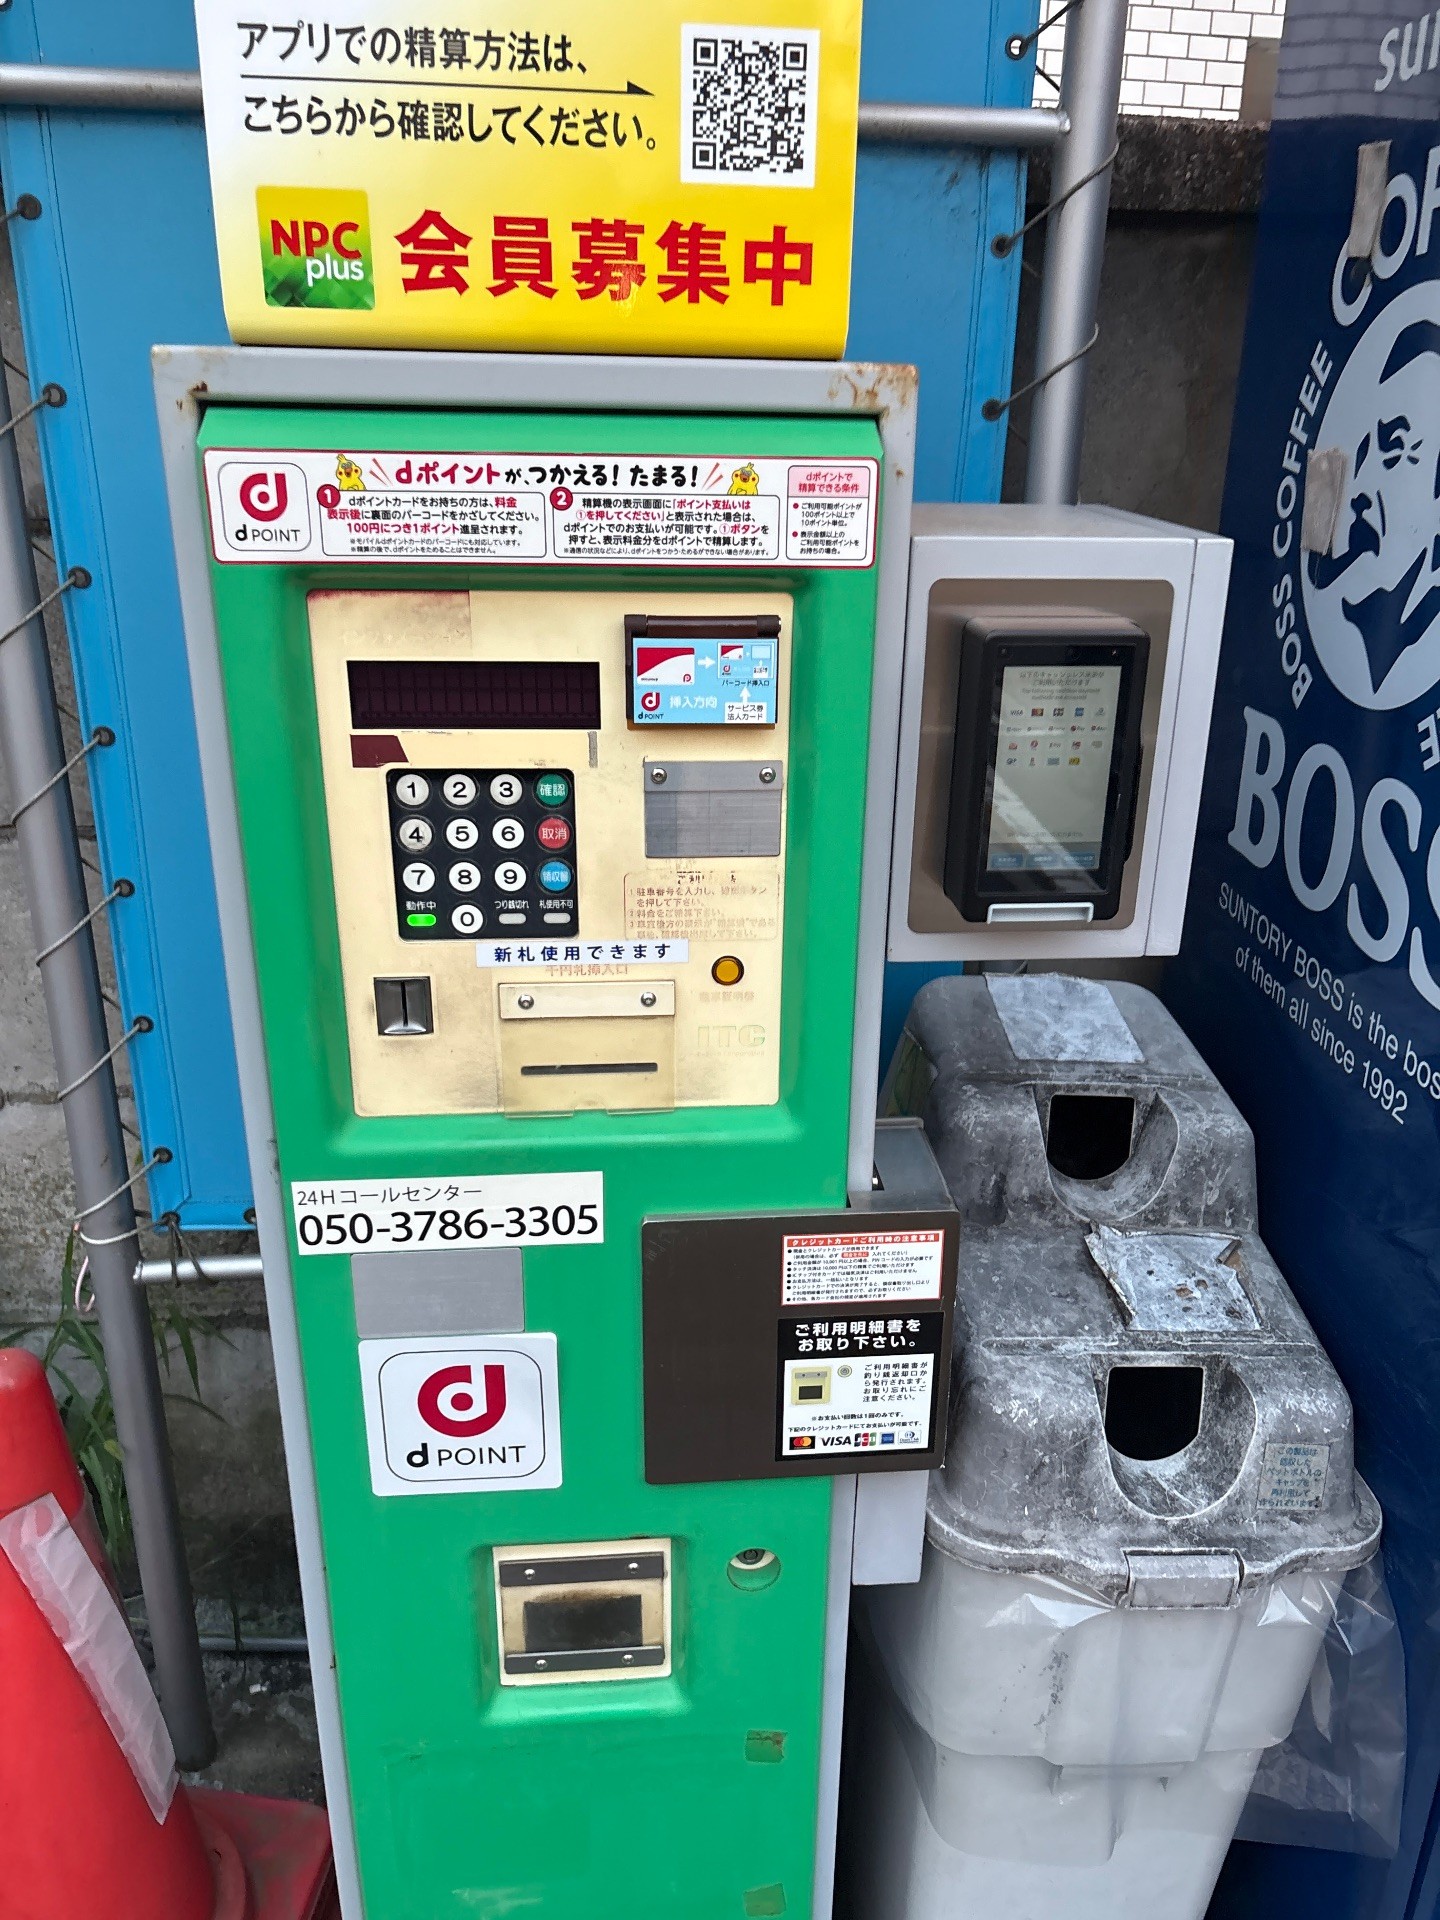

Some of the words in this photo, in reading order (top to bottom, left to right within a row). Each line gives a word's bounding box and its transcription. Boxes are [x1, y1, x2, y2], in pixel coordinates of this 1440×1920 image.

[237, 21, 589, 74] アプリでの精算方法は、
[242, 95, 656, 151] こちらから確認してください。
[270, 219, 361, 259] NPC
[395, 209, 814, 307] 会員募集中
[306, 256, 365, 287] plus
[1272, 340, 1333, 558] COFFEE
[806, 472, 853, 482] dポイントで
[799, 483, 859, 493] 精算できる条件
[349, 496, 518, 509] dポイントカードをお持ちの方は、料金
[582, 497, 751, 510] 精算機の表示画面に「ポイント支払いは
[801, 502, 862, 511] ご利用可能ポイントが
[327, 508, 541, 522] 表示後に裏面のバーコードをかざしてください。
[801, 511, 855, 519] 100ポイント以上で
[347, 522, 524, 536] 100円につき1ポイント進呈されます。
[569, 535, 763, 547] 押すと、表示料金分をdポイントで精算します。
[800, 539, 859, 547] ご利用可能ポイントを
[1272, 572, 1313, 710] BOSS
[722, 679, 770, 687] バーコード挿入口
[669, 695, 718, 709] 挿入方向
[727, 704, 764, 713] サービス券
[727, 713, 763, 721] 法人カード
[407, 782, 416, 798] 1
[452, 782, 467, 798] 2
[499, 782, 514, 798] 3
[540, 784, 566, 796] 確認
[408, 826, 424, 843] 4
[455, 826, 470, 842] 5
[501, 826, 516, 842] 6
[542, 828, 567, 840] 取消
[411, 870, 426, 886] 7
[457, 869, 472, 885] 8
[503, 869, 518, 884] 9
[406, 902, 437, 911] 動作中
[494, 900, 529, 910] つり銭切れ
[539, 899, 574, 909] 札使用不可
[460, 911, 475, 927] 0
[494, 942, 671, 963] 新札使用できます
[1219, 881, 1293, 963] SUNTORY
[1294, 945, 1345, 1012] BOSS
[1348, 992, 1364, 1030] is
[1369, 1011, 1399, 1060] the
[1235, 945, 1248, 969] of
[1250, 955, 1287, 1010] them
[1289, 997, 1308, 1030] all
[1311, 1019, 1355, 1074] since
[1361, 1060, 1409, 1126] 1992
[299, 1204, 599, 1246] 050-3786-3305
[792, 1233, 935, 1246] クレジットカードご利用時の注意事項
[795, 1319, 921, 1337] ご利用明細書を
[798, 1335, 916, 1352] お取り下さい。
[865, 1361, 928, 1371] ご利用明細書が
[864, 1370, 928, 1379] 釣り銭返却口か
[864, 1378, 926, 1387] ら発行されます。
[863, 1386, 926, 1395] お取り忘れにご
[863, 1394, 916, 1402] 注意ください。
[821, 1436, 852, 1447] VISA
[437, 1445, 526, 1466] POINT
